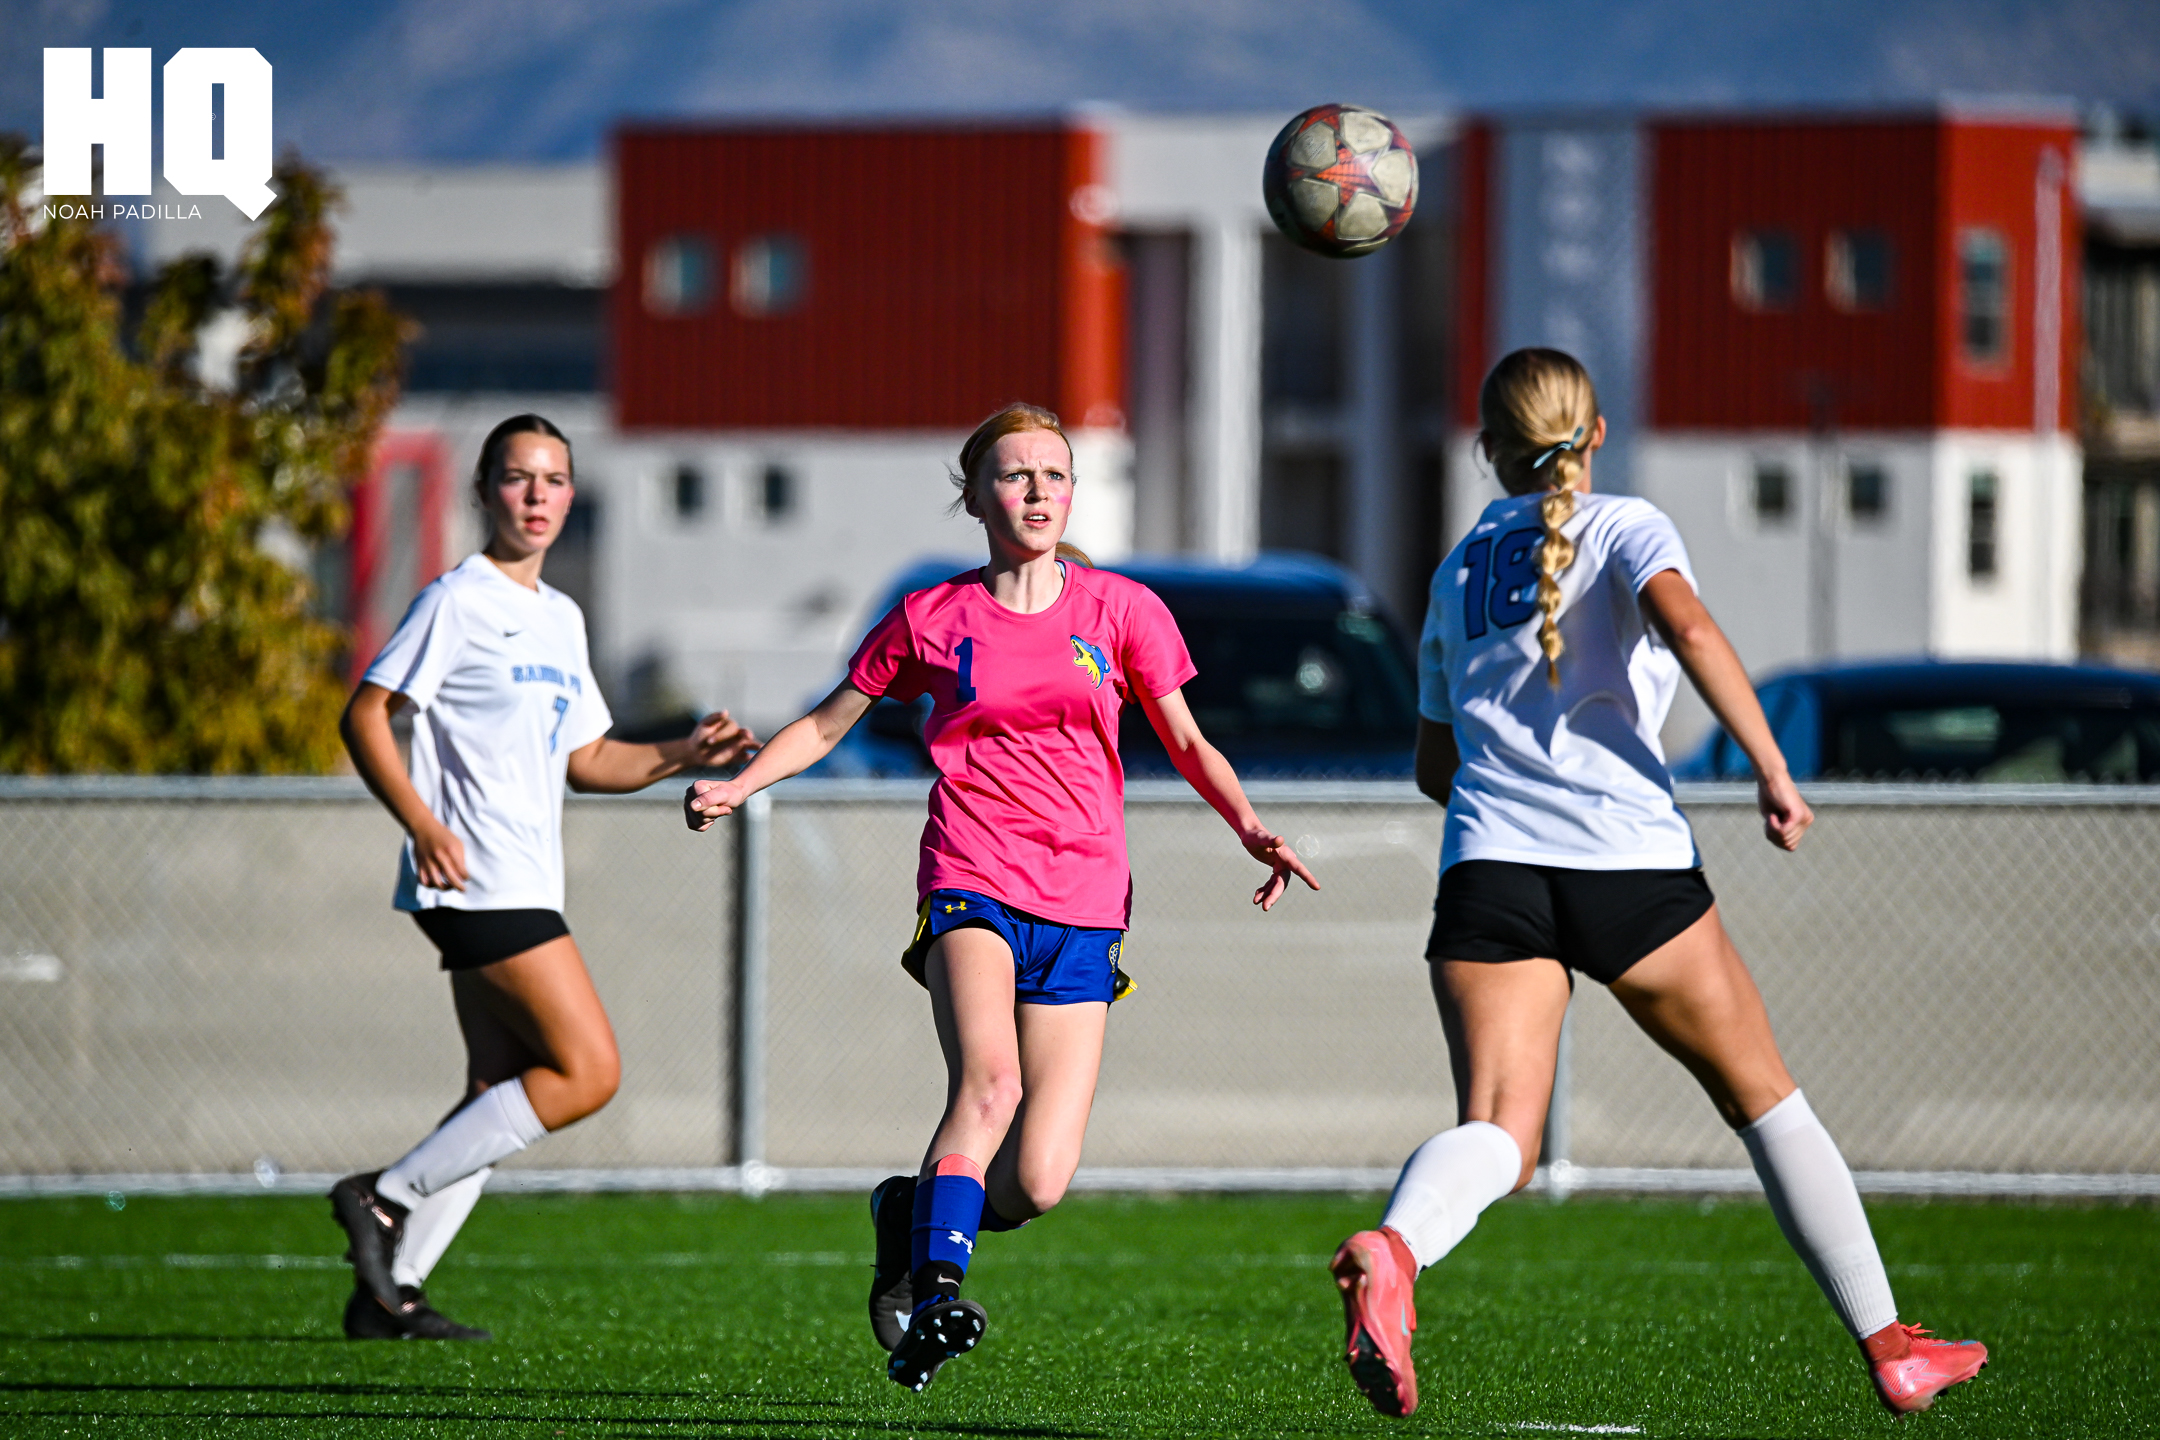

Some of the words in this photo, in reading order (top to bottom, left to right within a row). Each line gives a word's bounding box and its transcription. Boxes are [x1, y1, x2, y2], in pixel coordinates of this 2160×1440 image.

[1463, 526, 1545, 641] 18
[954, 636, 977, 702] 1
[549, 695, 569, 756] 7
